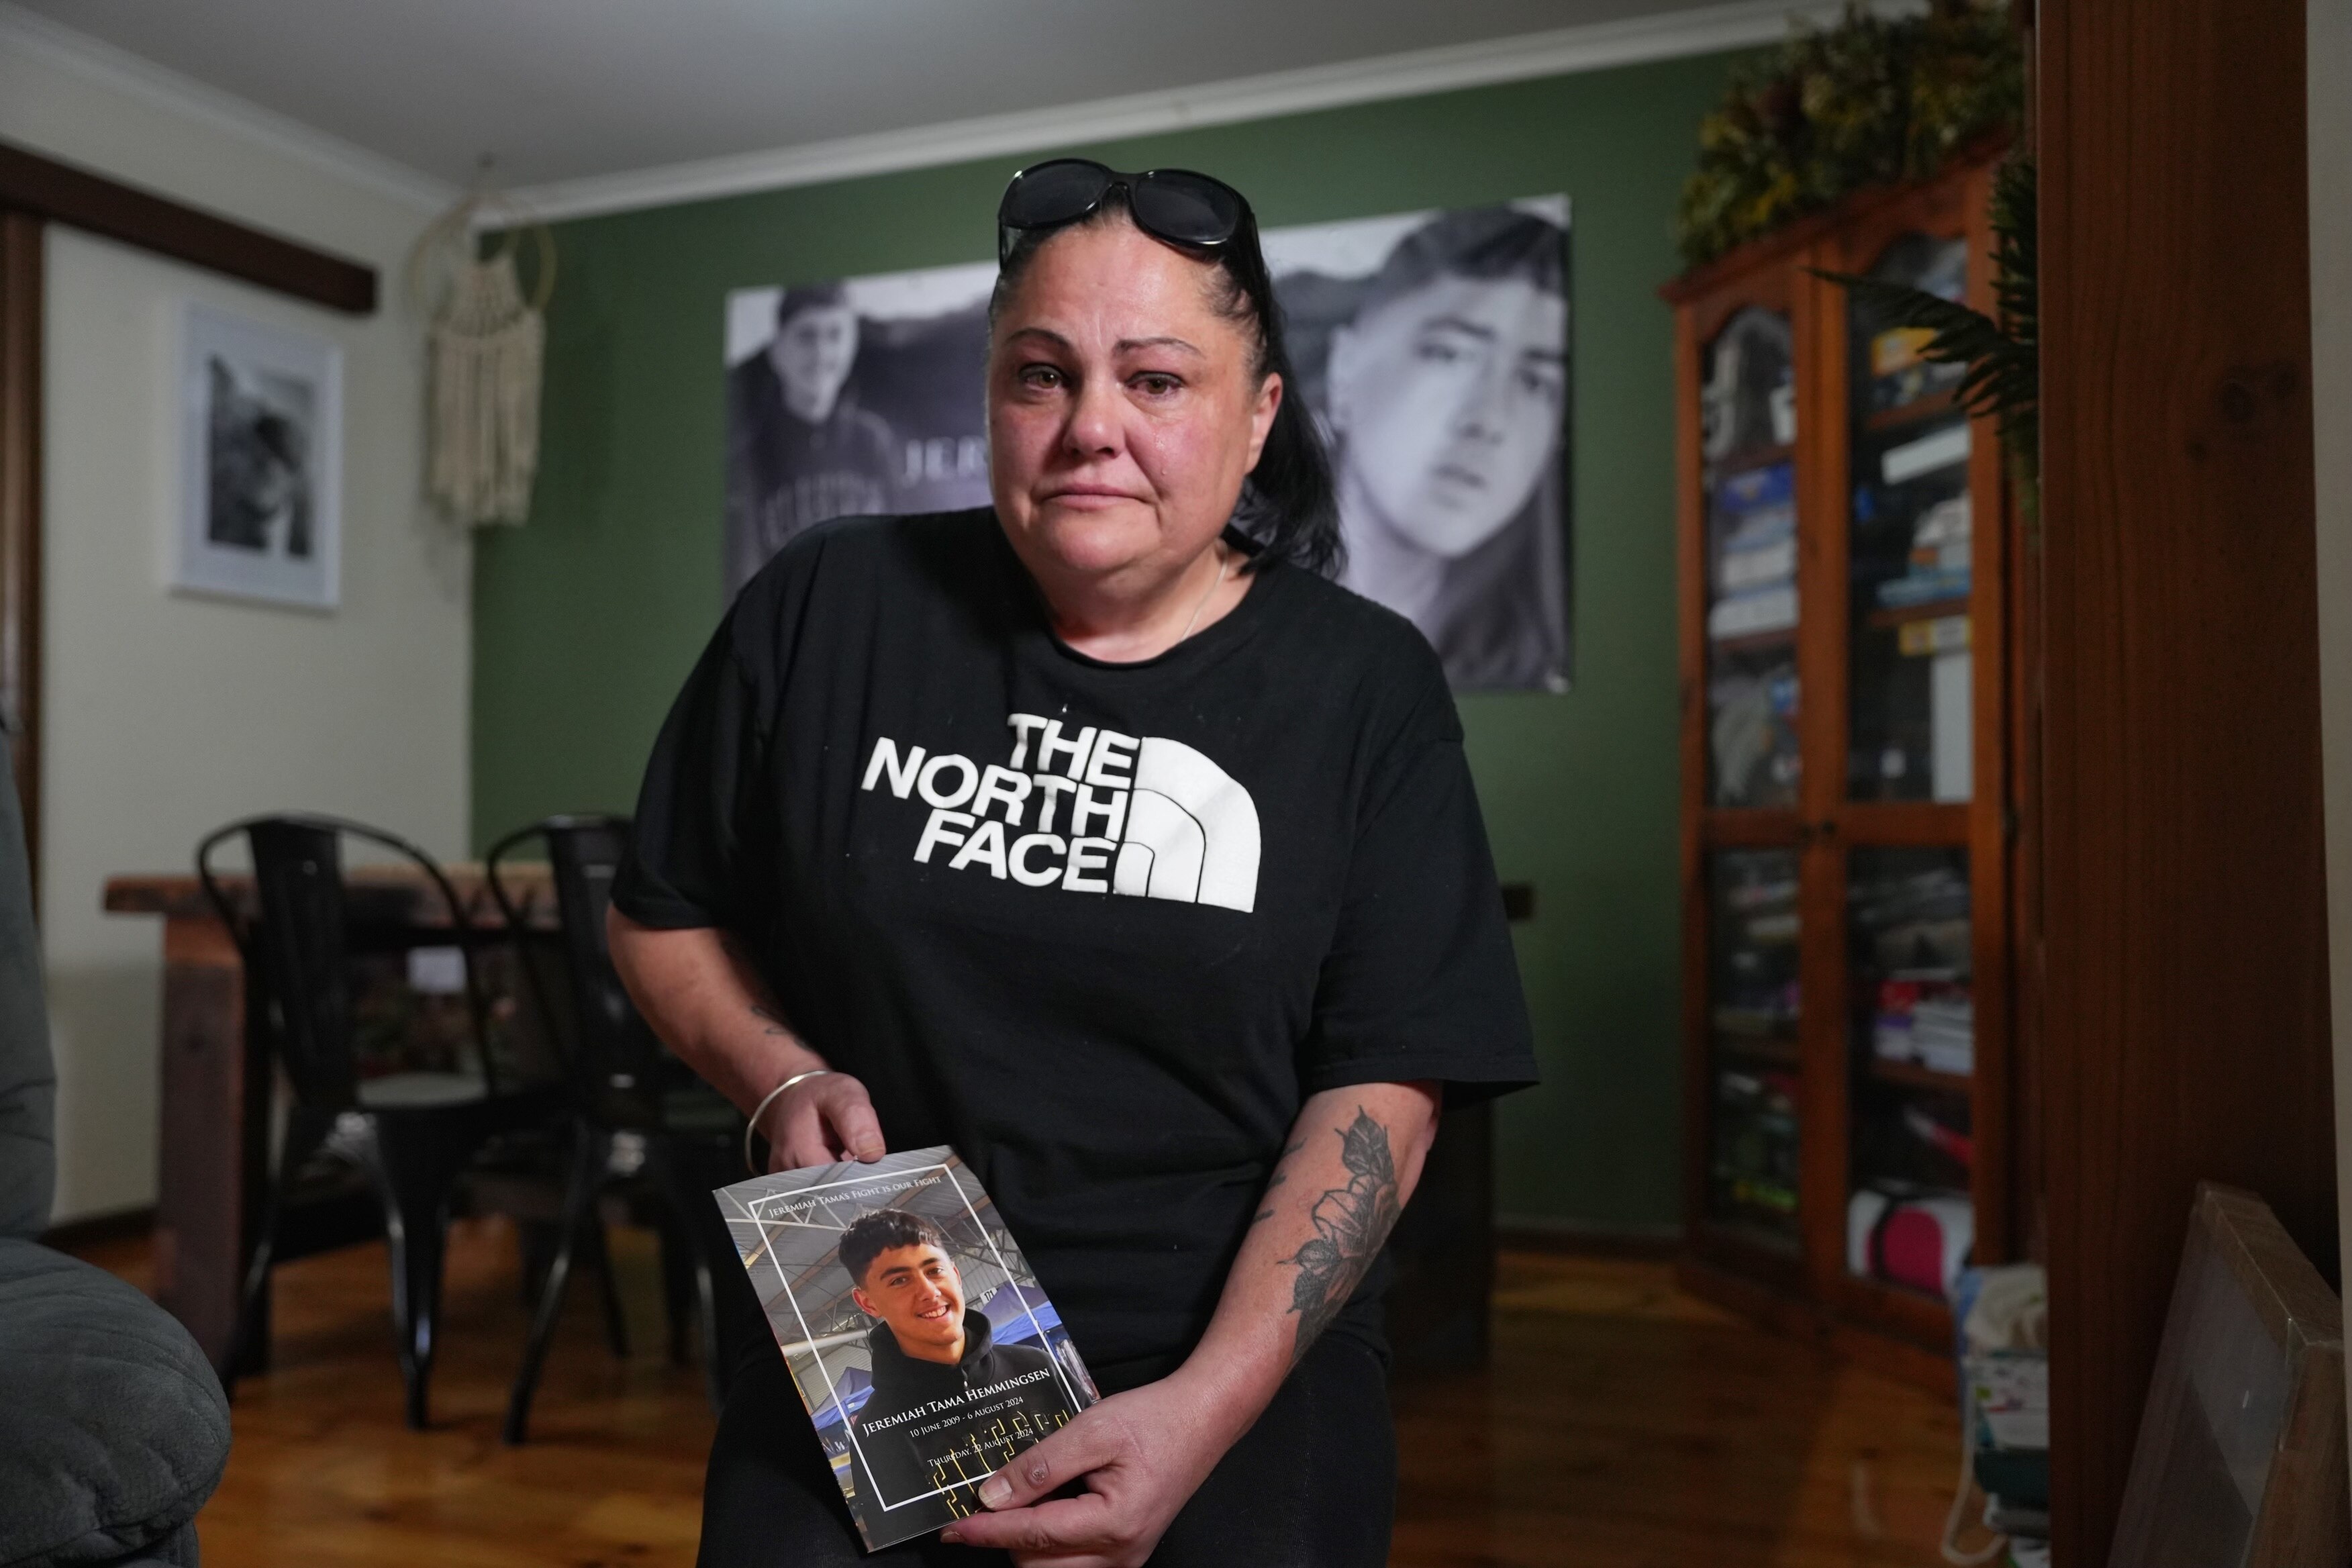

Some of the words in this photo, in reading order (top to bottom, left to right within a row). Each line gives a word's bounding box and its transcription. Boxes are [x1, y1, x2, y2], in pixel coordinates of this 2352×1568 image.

[1008, 713, 1140, 789] THE
[861, 736, 1128, 842] NORTH
[914, 808, 1117, 893] FACE
[769, 1199, 816, 1218] JEREMIAH
[818, 1192, 850, 1205] TAMA'S
[851, 1187, 880, 1199] FIGHT
[881, 1185, 891, 1193] IS
[892, 1181, 914, 1191] OUR
[912, 1176, 941, 1187] FIGHT
[862, 1406, 927, 1437] JEREMIAH
[927, 1395, 965, 1413] TAMA
[965, 1368, 1050, 1402] HEMMINGSEN
[910, 1428, 920, 1438] 10
[920, 1422, 942, 1435] JUNE
[941, 1416, 961, 1428] 2009
[975, 1402, 1005, 1418] AUGUST
[1005, 1396, 1024, 1408] 2024
[972, 1444, 983, 1453] 22
[984, 1434, 1014, 1449] AUGUST
[1014, 1428, 1034, 1440] 2024
